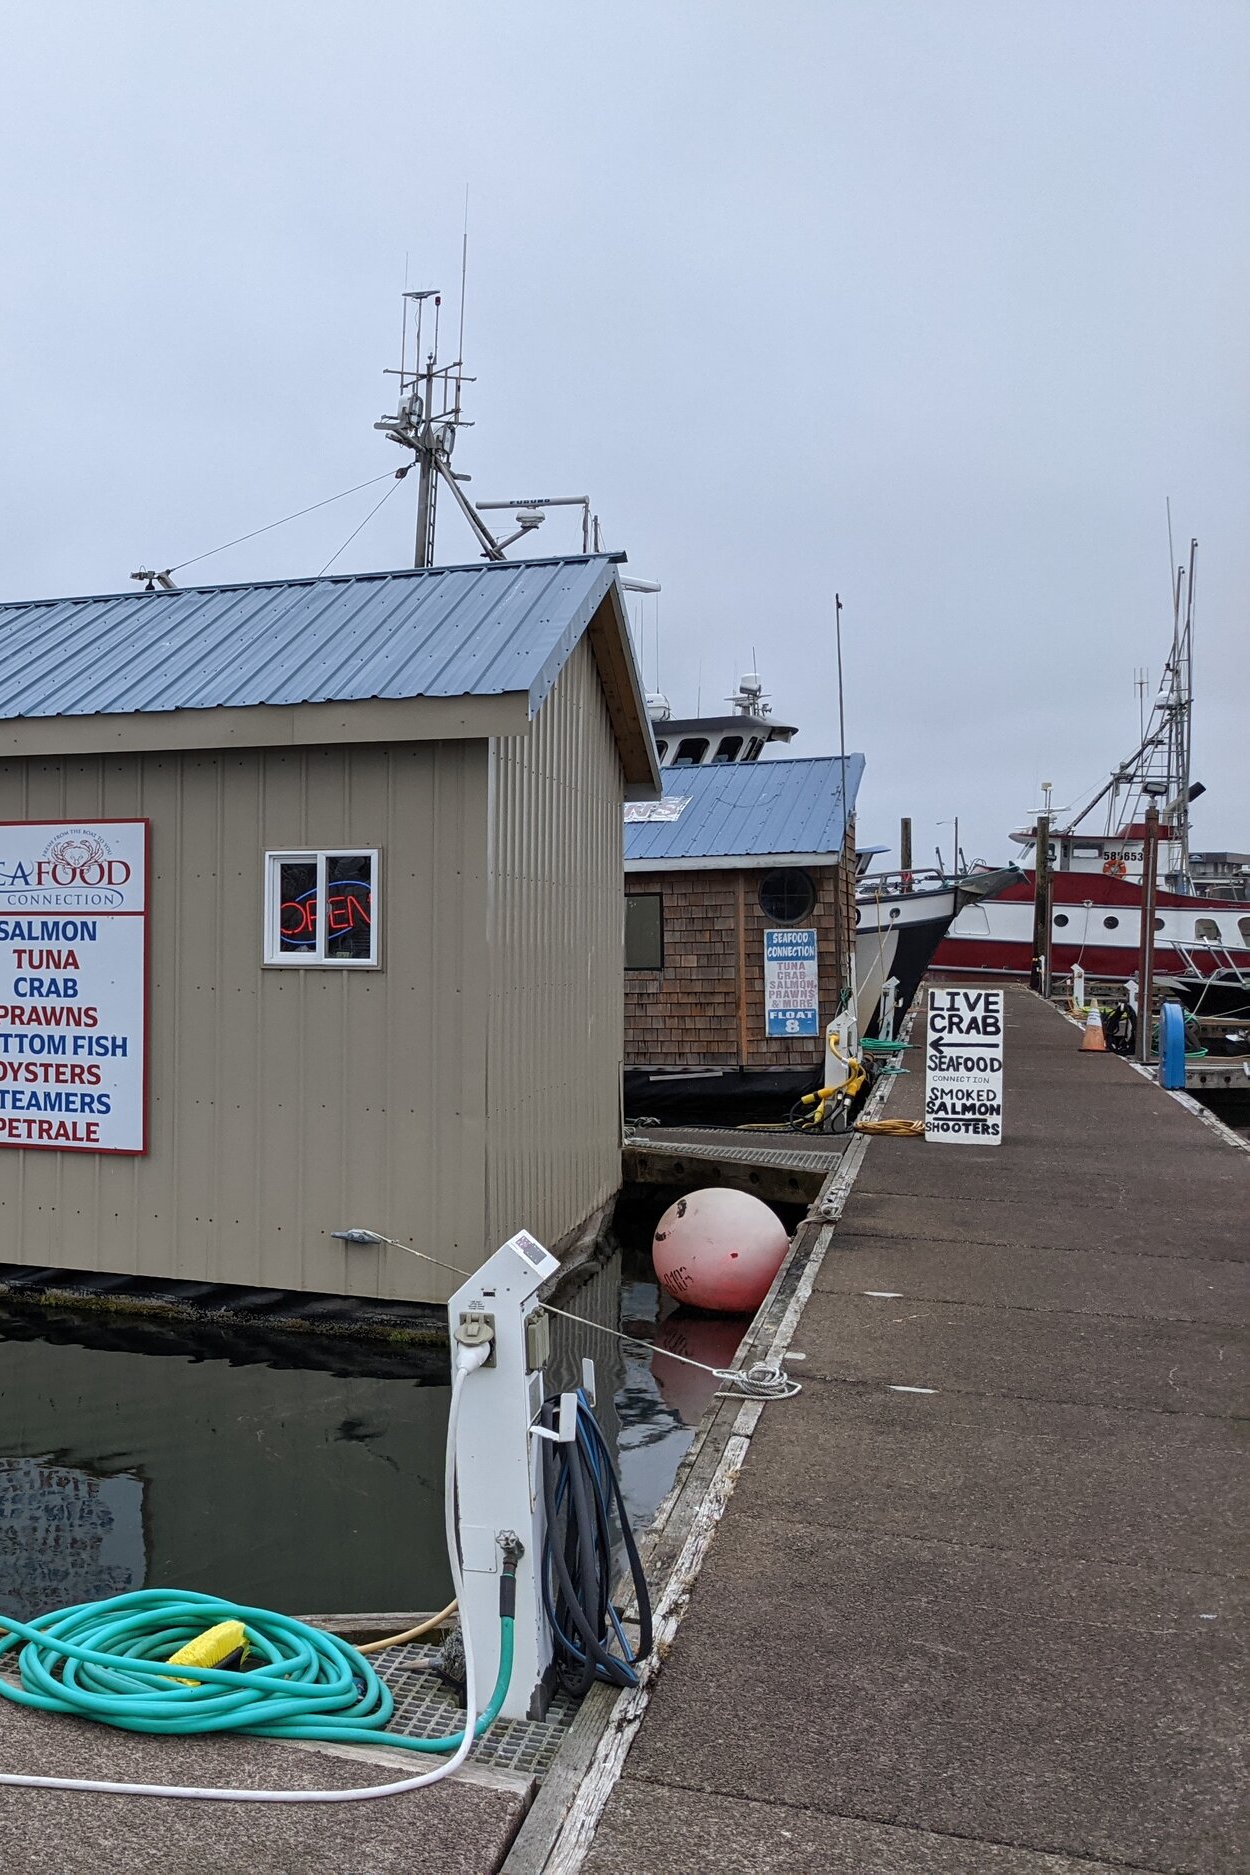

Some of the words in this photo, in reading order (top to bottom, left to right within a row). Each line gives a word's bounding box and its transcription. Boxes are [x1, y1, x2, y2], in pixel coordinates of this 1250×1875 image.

[7, 893, 115, 906] CONNECTION
[772, 932, 809, 944] SEAFOOD
[767, 945, 815, 957] CONNECTION
[12, 949, 80, 970] TUNA
[777, 962, 805, 971] TUNA
[777, 971, 806, 980] CRAB
[13, 976, 79, 999] CRAB
[770, 980, 815, 990] SALMON
[768, 990, 815, 999] PRAWNS
[771, 1000, 779, 1008] &
[782, 999, 813, 1008] MORE
[929, 991, 1000, 1014] LIVE
[770, 1011, 815, 1019] FLOAT
[785, 1019, 800, 1033] 8
[929, 1013, 1001, 1036] CRAB
[72, 1036, 128, 1057] FISH
[927, 1054, 1002, 1073] SEAFOOD
[932, 1075, 990, 1084] CONNECTION
[929, 1086, 997, 1102] SMOKED
[926, 1101, 1001, 1116] SALMON
[925, 1122, 1000, 1136] SHOOTERS
